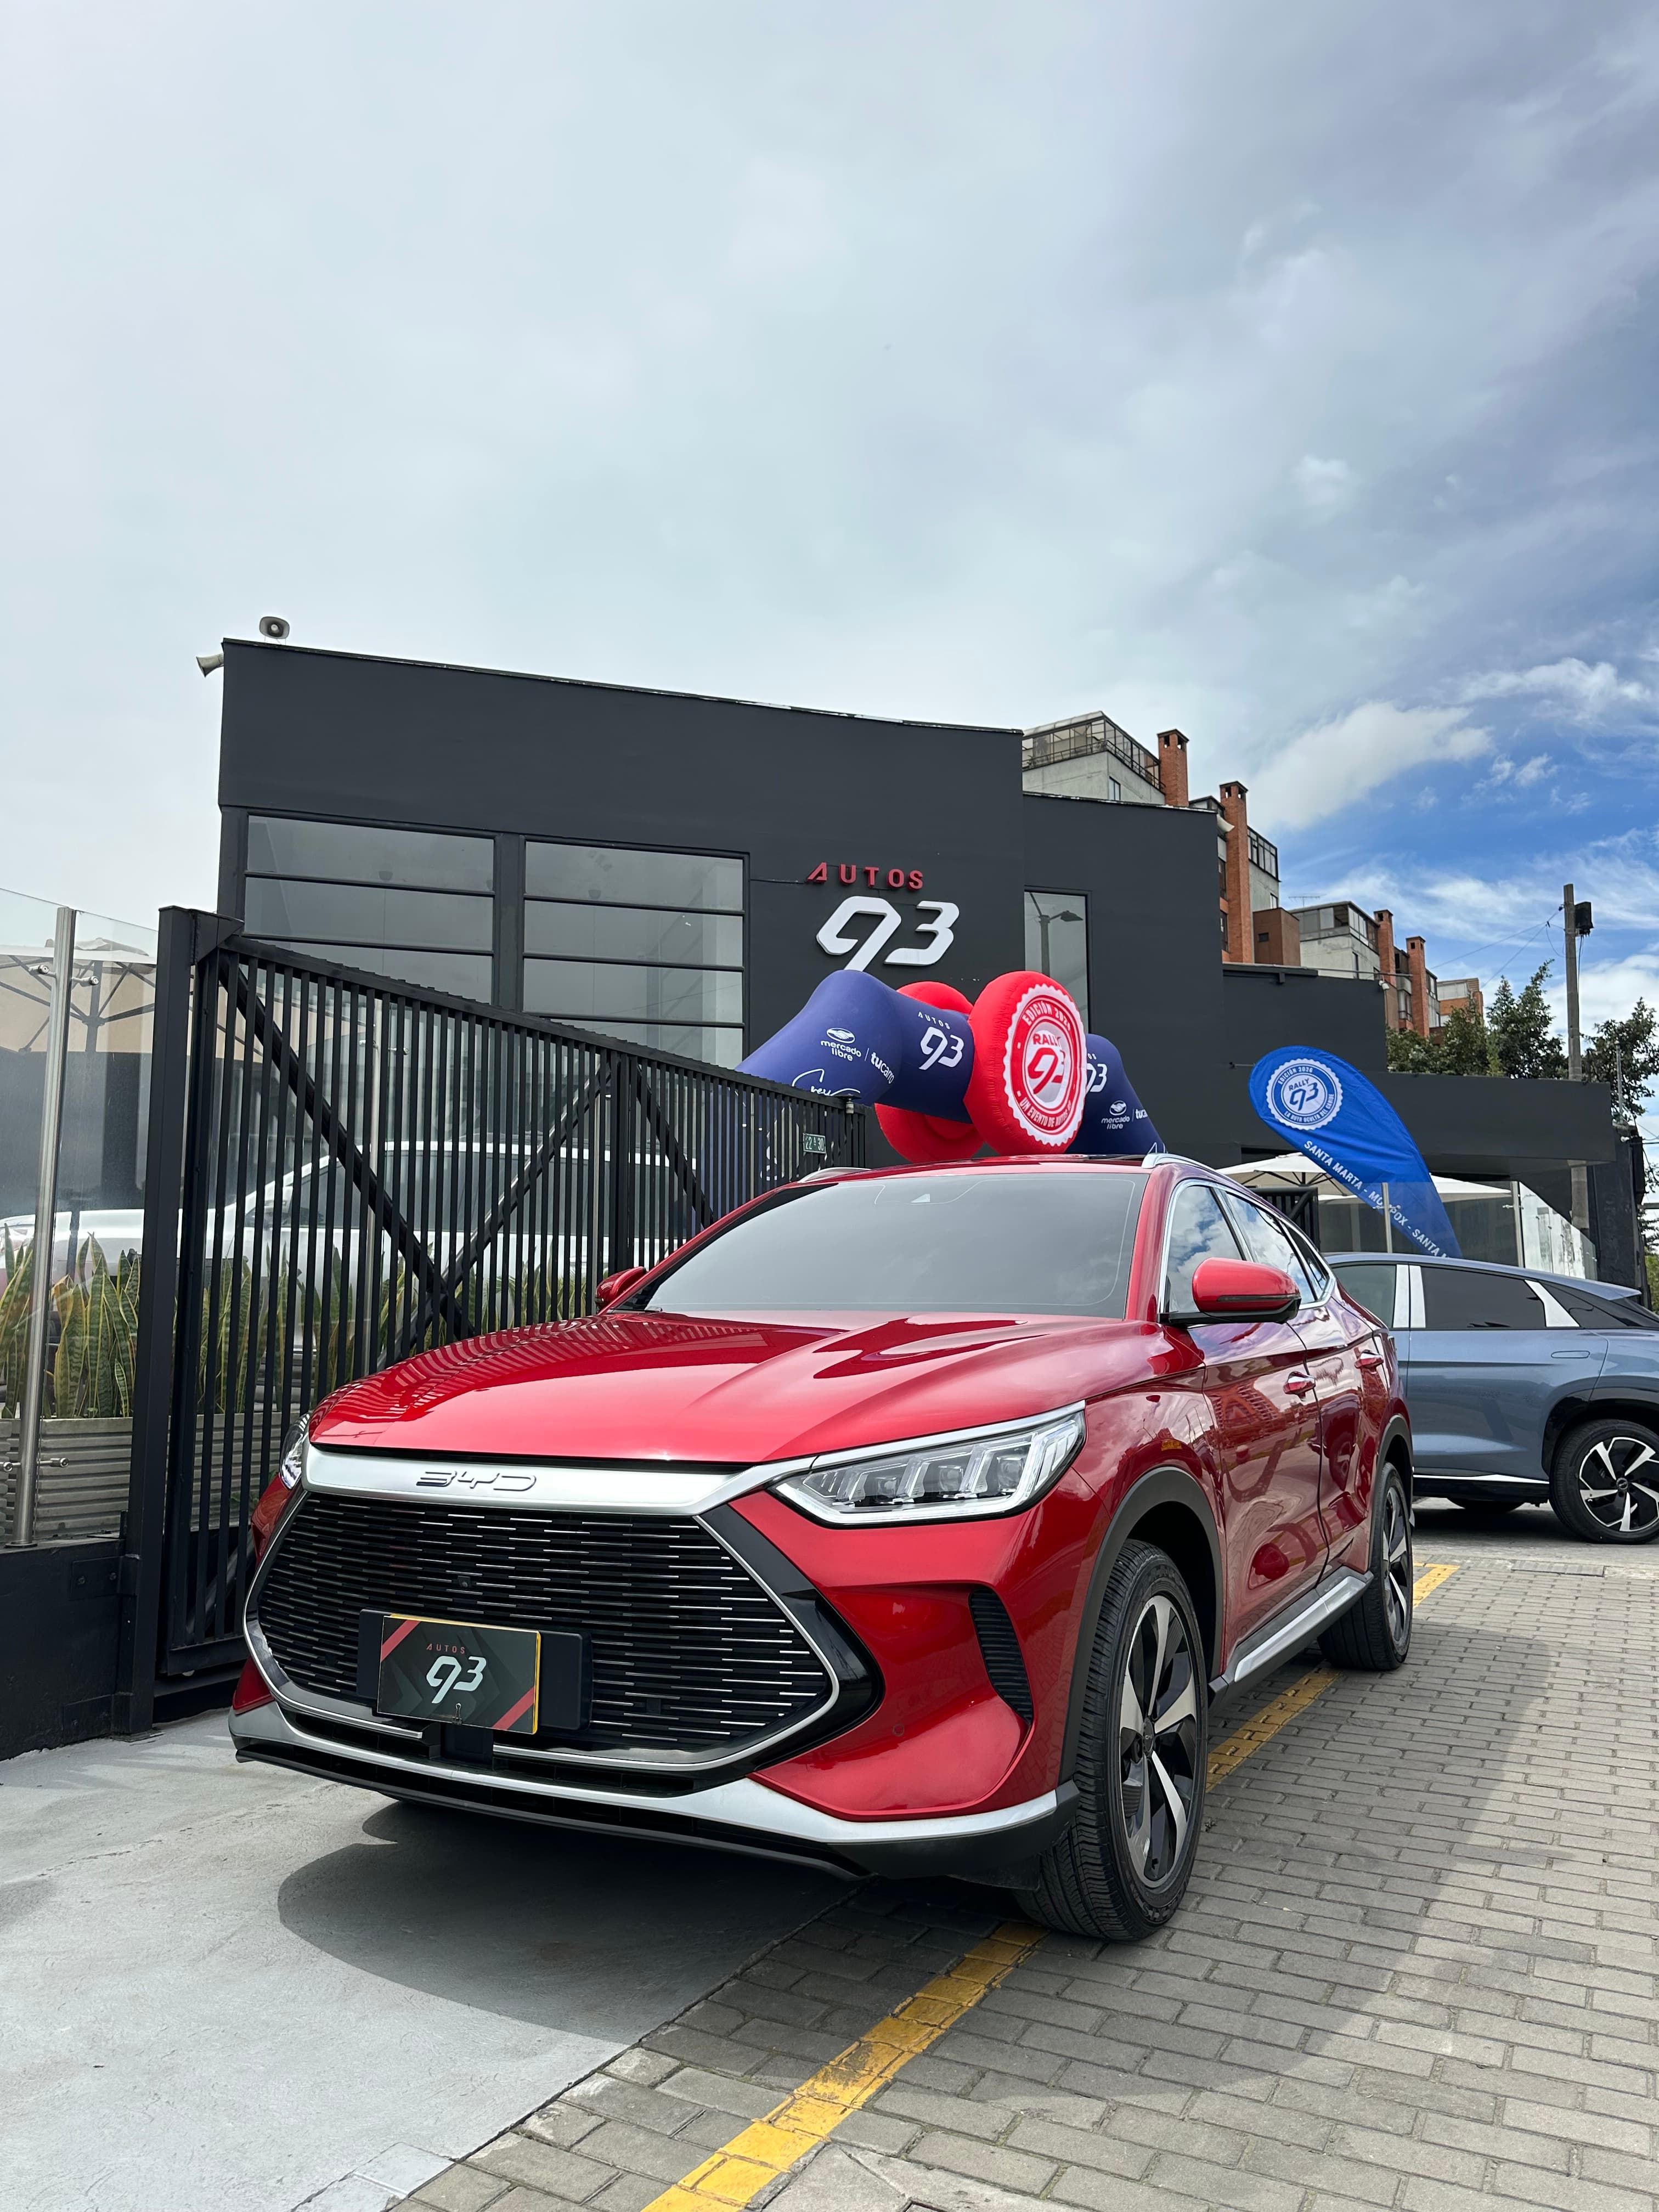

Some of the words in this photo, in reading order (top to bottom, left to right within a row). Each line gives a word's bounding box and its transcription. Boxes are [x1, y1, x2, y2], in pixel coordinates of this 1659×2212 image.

[805, 862, 923, 891] AUTOS
[816, 895, 960, 972] 93
[918, 1012, 951, 1030] AUTOS
[1022, 1001, 1052, 1026] EDICIÓN
[821, 1040, 861, 1058] mercado
[831, 1048, 853, 1062] libre
[918, 1026, 964, 1070] 93
[871, 1052, 895, 1084] tucarro
[1288, 1078, 1310, 1091] RALLY
[1289, 1082, 1318, 1111] 93
[1019, 1097, 1030, 1111] UN
[1027, 1107, 1048, 1126] EVENTO
[1048, 1117, 1056, 1128] DE
[1101, 1115, 1130, 1124] mercado
[1304, 1141, 1333, 1166] SANTA
[1332, 1163, 1363, 1190] MARTA
[1368, 1191, 1408, 1226] MOPOX
[1412, 1229, 1440, 1256] SANTA
[416, 1470, 537, 1492] BYD
[426, 1643, 465, 1654] AUTOS
[426, 1656, 487, 1703] 93
